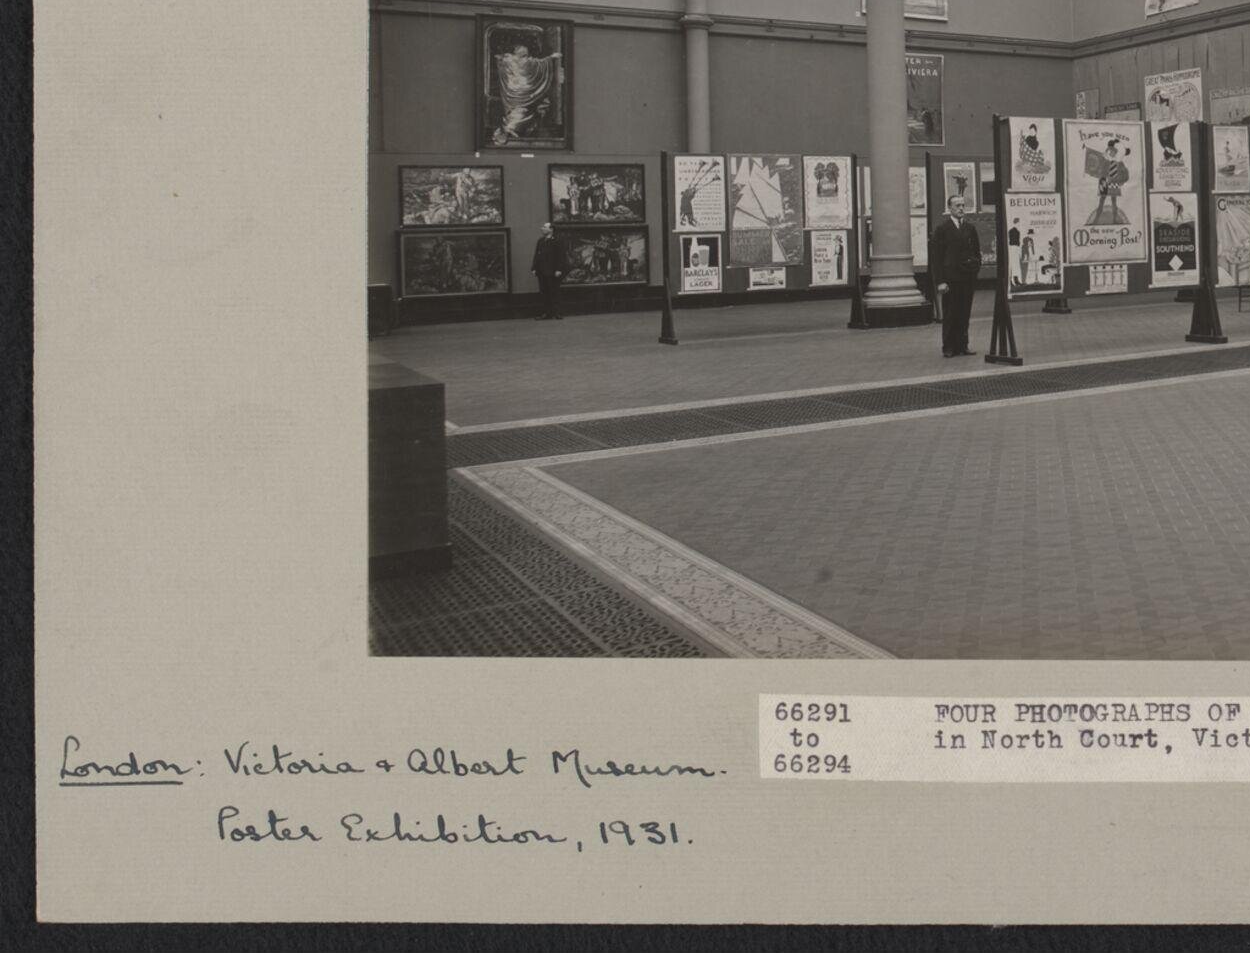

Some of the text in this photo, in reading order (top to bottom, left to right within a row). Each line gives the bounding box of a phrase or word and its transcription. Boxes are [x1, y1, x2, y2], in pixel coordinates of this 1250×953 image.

[905, 68, 938, 77] IVIERA
[1010, 197, 1056, 207] BELGIUM
[1155, 245, 1195, 253] SOUTHEND
[775, 702, 851, 723] 66291
[934, 703, 997, 723] FOUR
[1014, 703, 1191, 723] PHOTOGRAPHS
[1208, 703, 1241, 722] OF
[789, 727, 820, 748] to
[934, 730, 966, 749] in
[981, 729, 1063, 749] North
[1080, 728, 1173, 755] Court,
[223, 741, 365, 777] Victoria
[406, 746, 527, 777] Albert
[774, 753, 851, 774] 66294
[217, 805, 324, 843] Poster
[599, 819, 695, 846] 1931.
